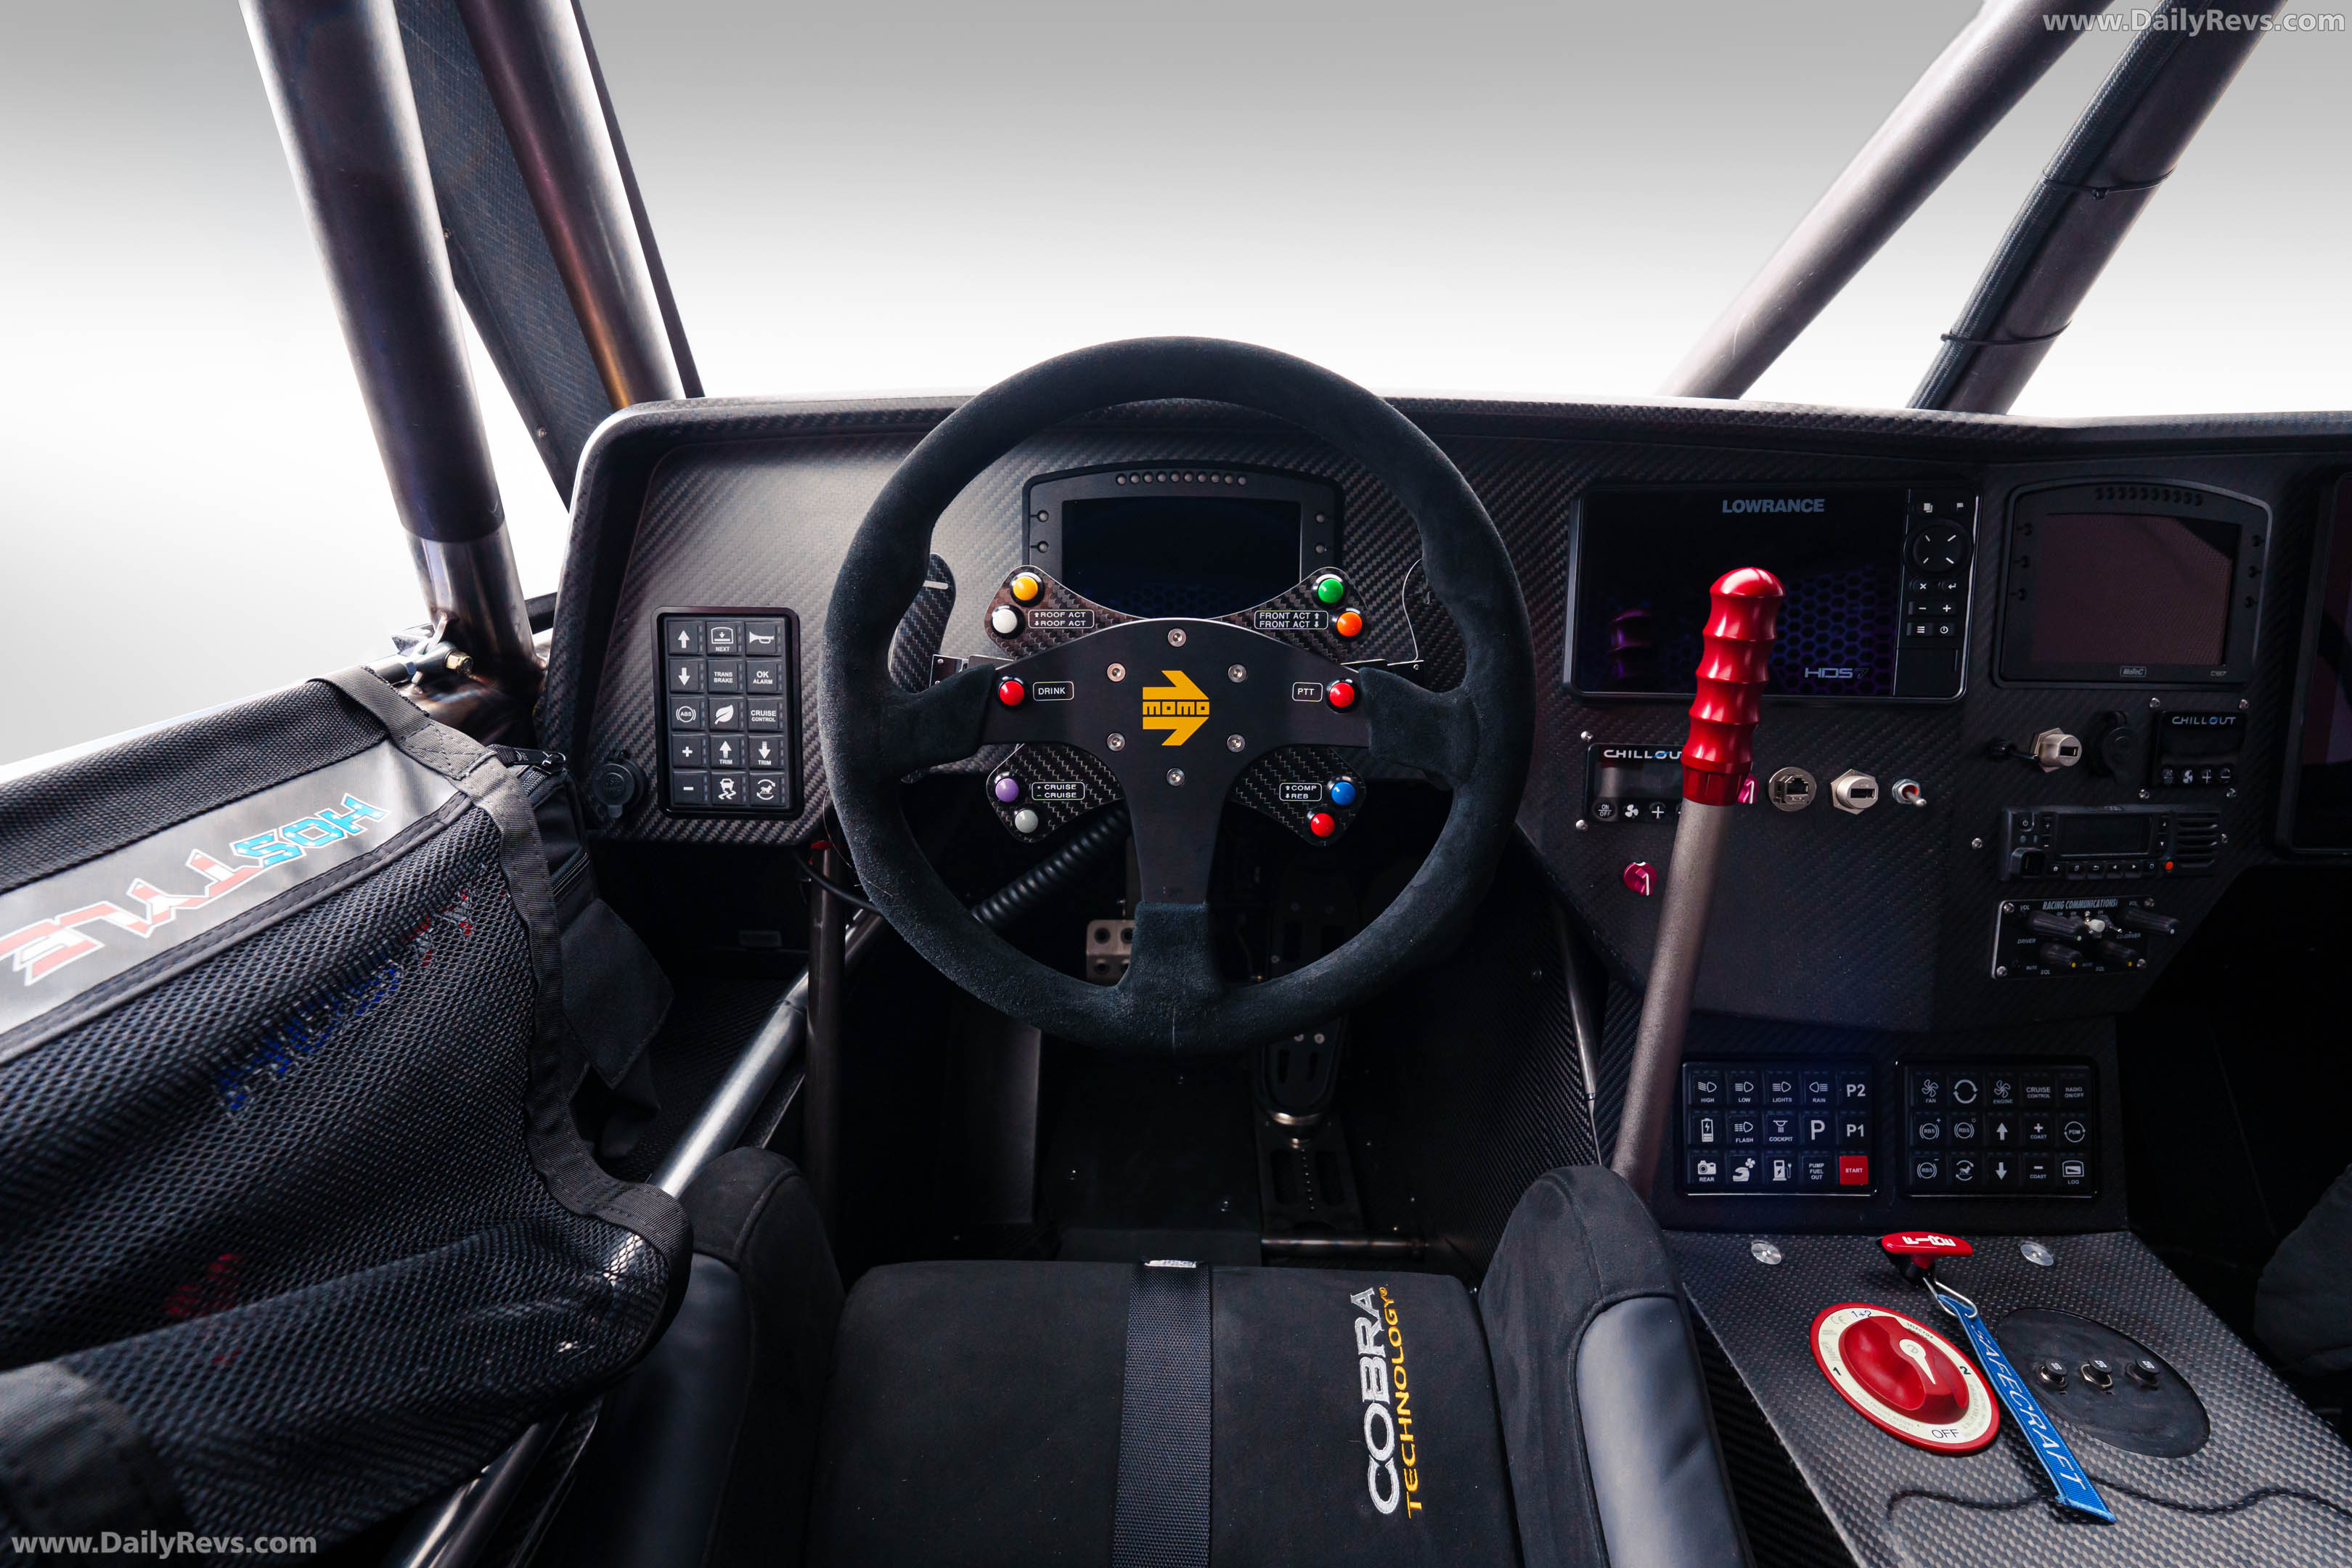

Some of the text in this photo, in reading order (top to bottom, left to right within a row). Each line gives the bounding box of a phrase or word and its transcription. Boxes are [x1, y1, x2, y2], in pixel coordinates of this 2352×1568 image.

[1722, 499, 1825, 513] LOWRANCE
[2171, 716, 2236, 726] CHILLOUT
[1604, 749, 1682, 760] CHILLOU
[2043, 898, 2117, 910] RACING COMMUNICATIONS
[1846, 1084, 1866, 1097] P2
[1811, 1120, 1825, 1140] P
[1846, 1124, 1864, 1138] P1
[1903, 1236, 1956, 1246] FIRE
[1832, 1367, 1842, 1376] 1
[1960, 1366, 1971, 1375] 2
[1350, 1286, 1400, 1514] COBRA
[1974, 1327, 2086, 1490] SAFECRAFT
[1931, 1429, 1959, 1439] OFF
